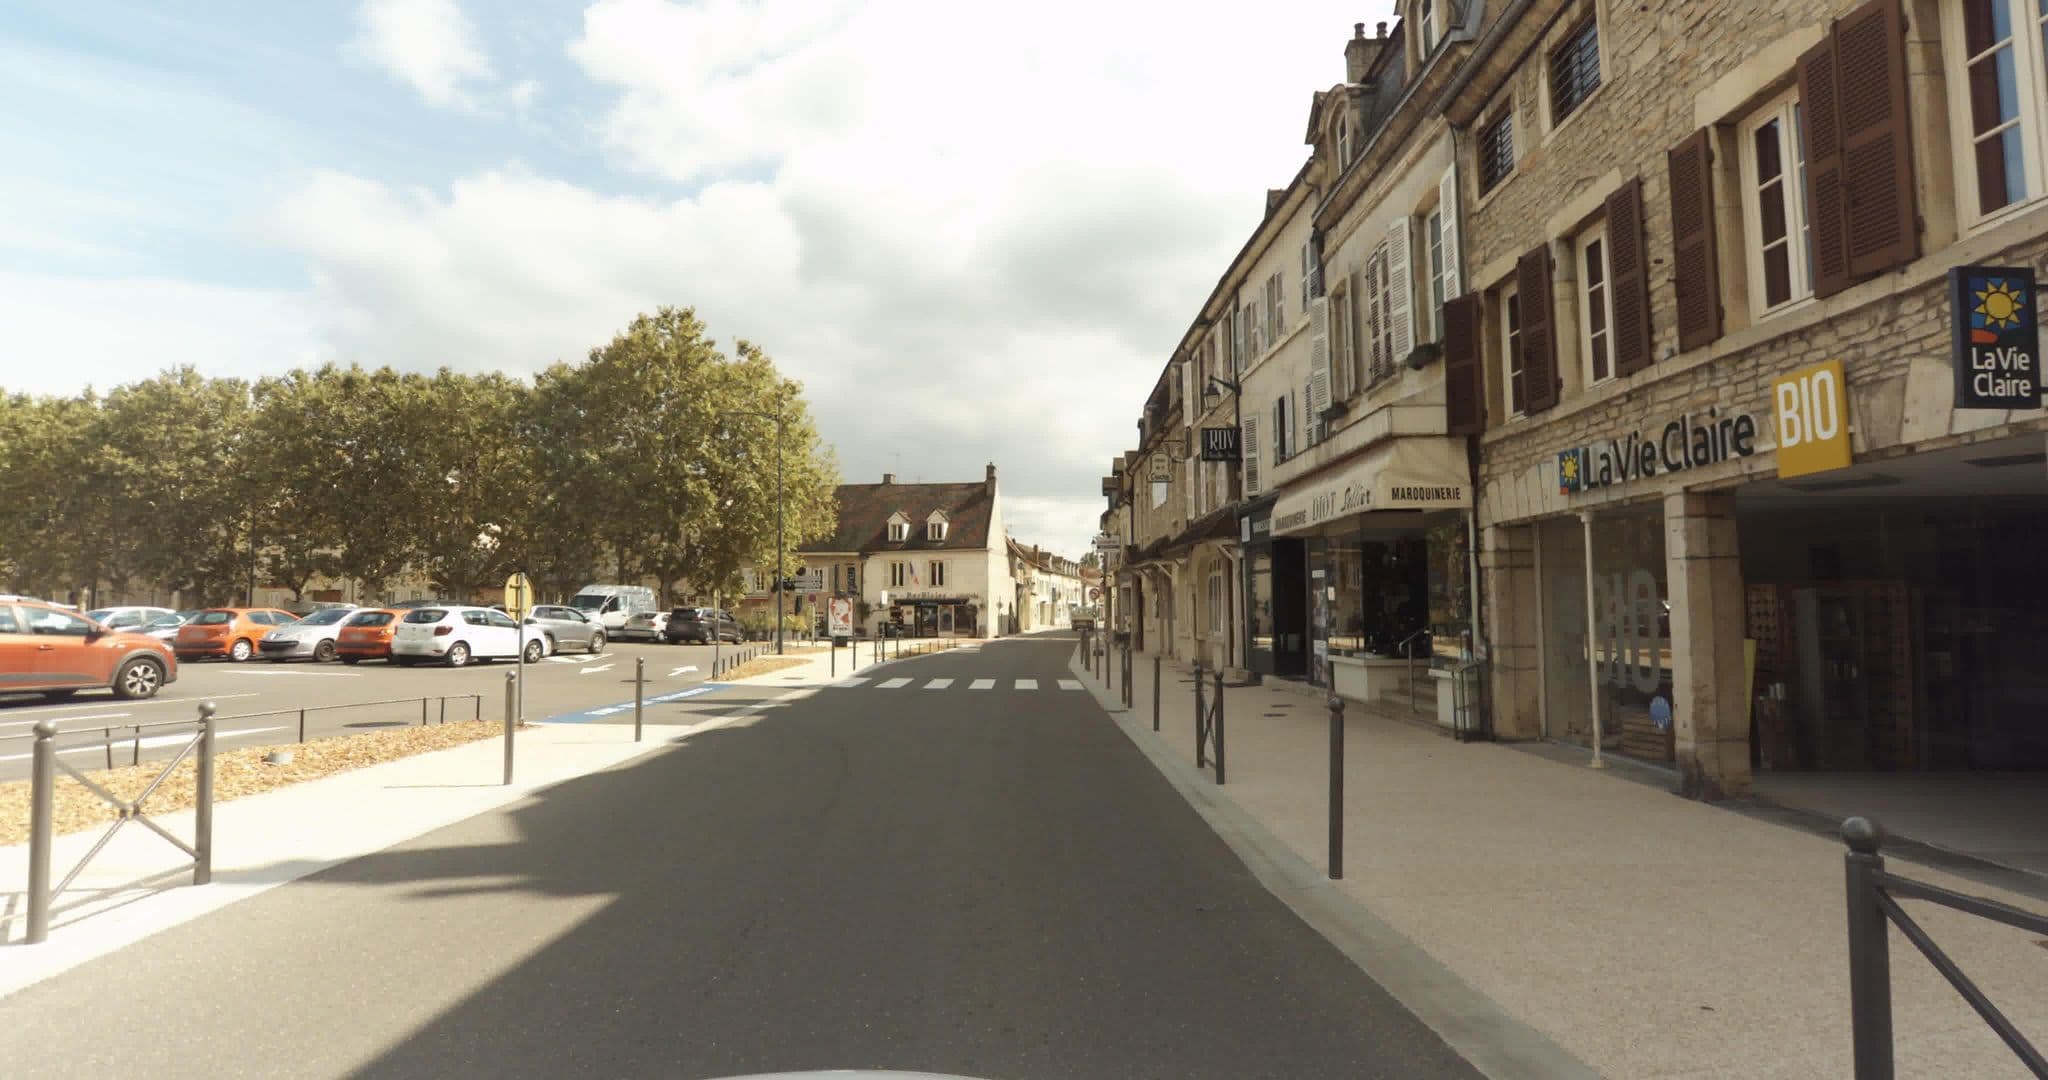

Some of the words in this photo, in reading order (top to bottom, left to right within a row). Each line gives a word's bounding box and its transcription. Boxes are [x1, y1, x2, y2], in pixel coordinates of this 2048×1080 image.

[1973, 371, 2032, 397] Claire
[1776, 369, 1839, 449] BIO
[1661, 406, 1757, 473] Claire
[1391, 486, 1462, 501] MAROQUINERIE
